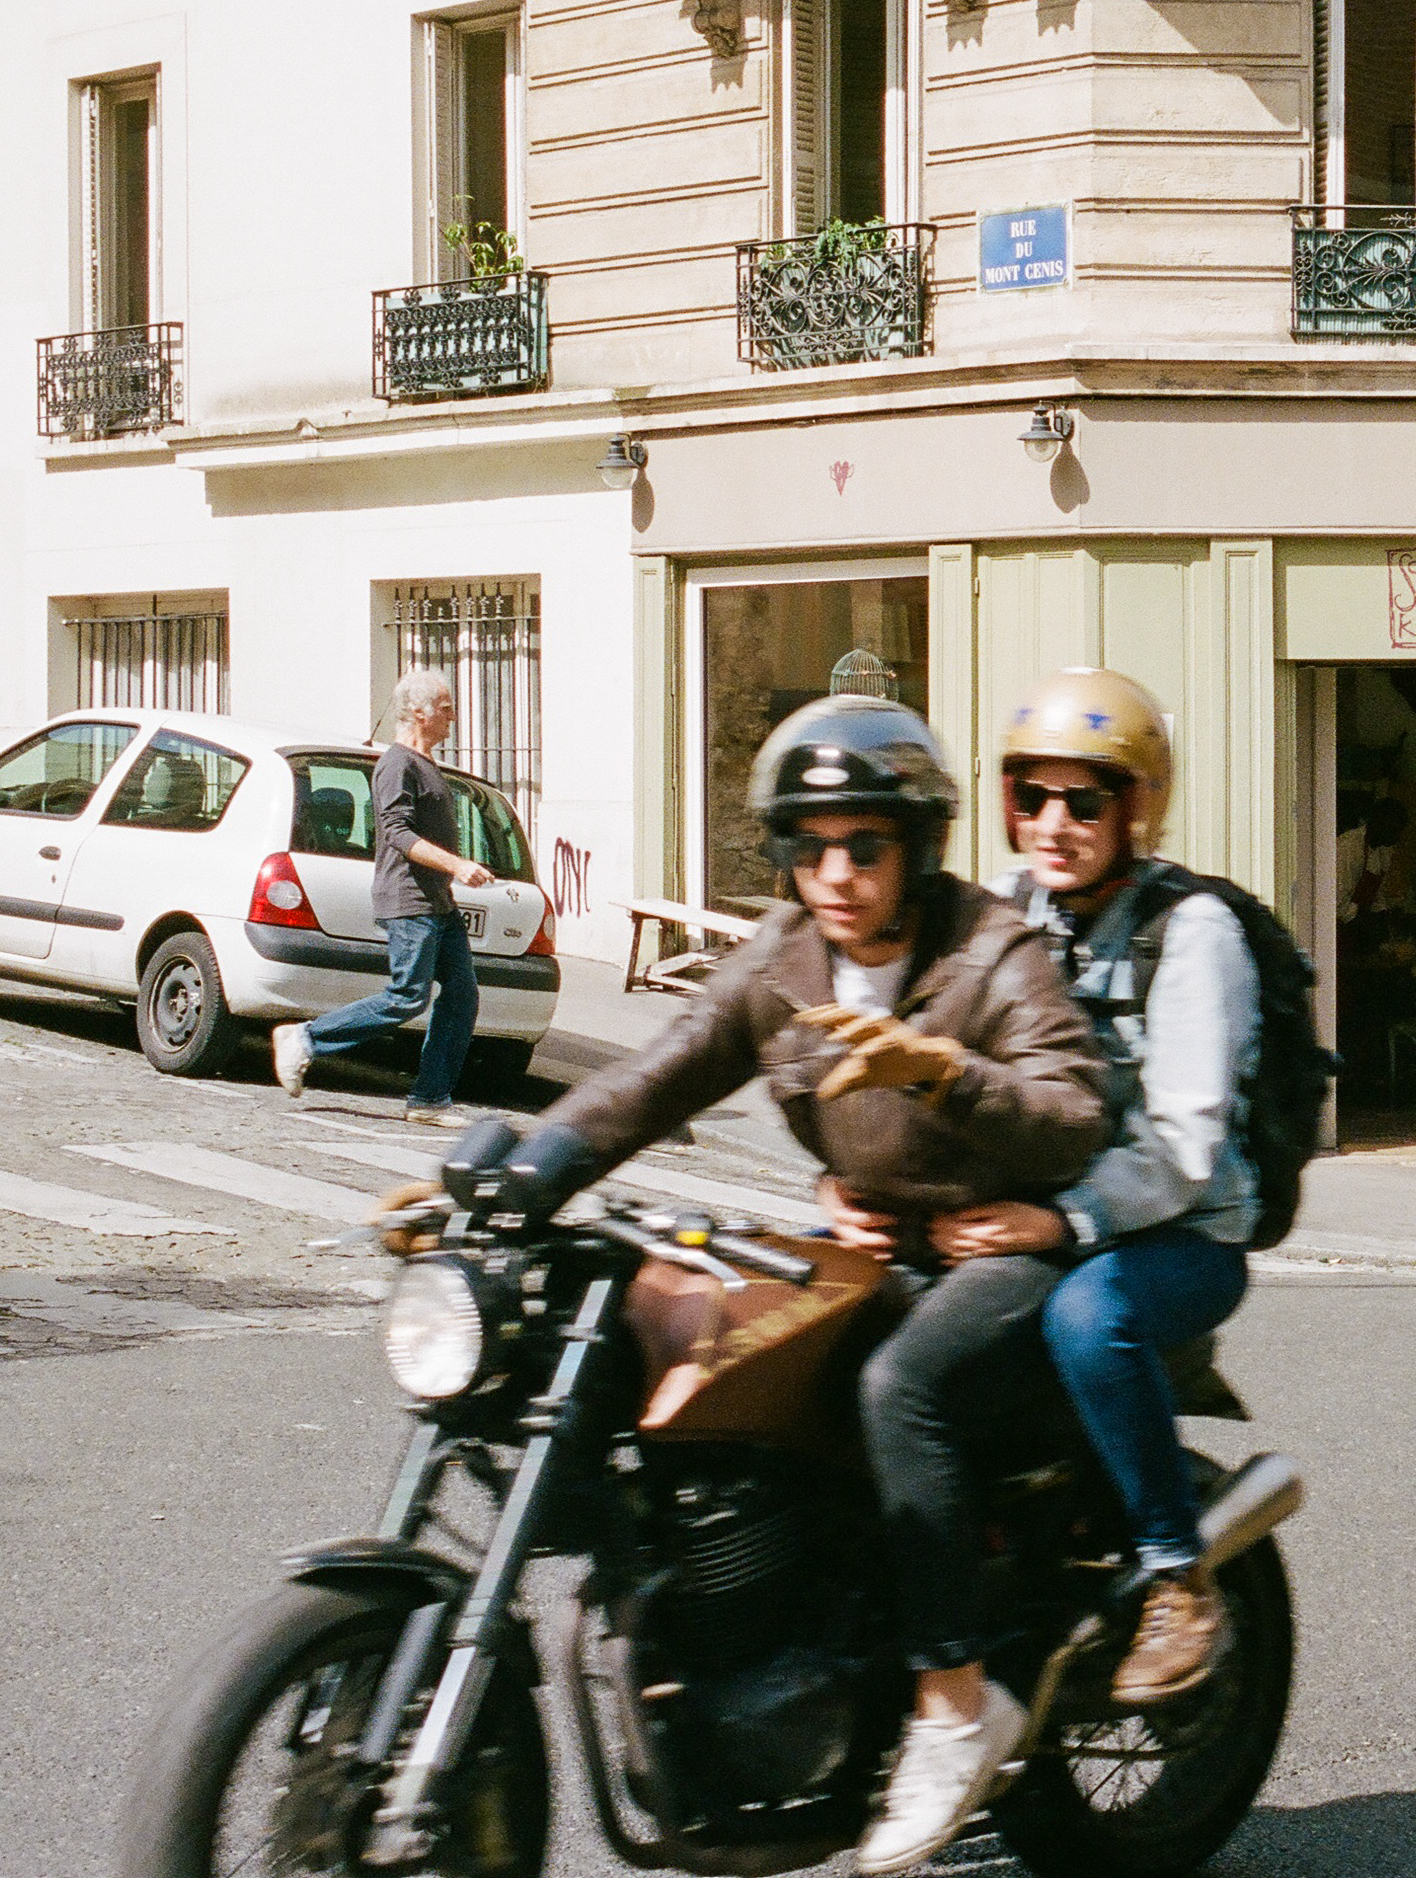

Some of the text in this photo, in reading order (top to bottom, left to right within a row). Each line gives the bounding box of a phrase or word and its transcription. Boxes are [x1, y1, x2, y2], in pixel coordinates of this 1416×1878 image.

[1010, 220, 1036, 238] RUE
[1015, 241, 1033, 258] DU
[985, 260, 1063, 283] MONT CENIS
